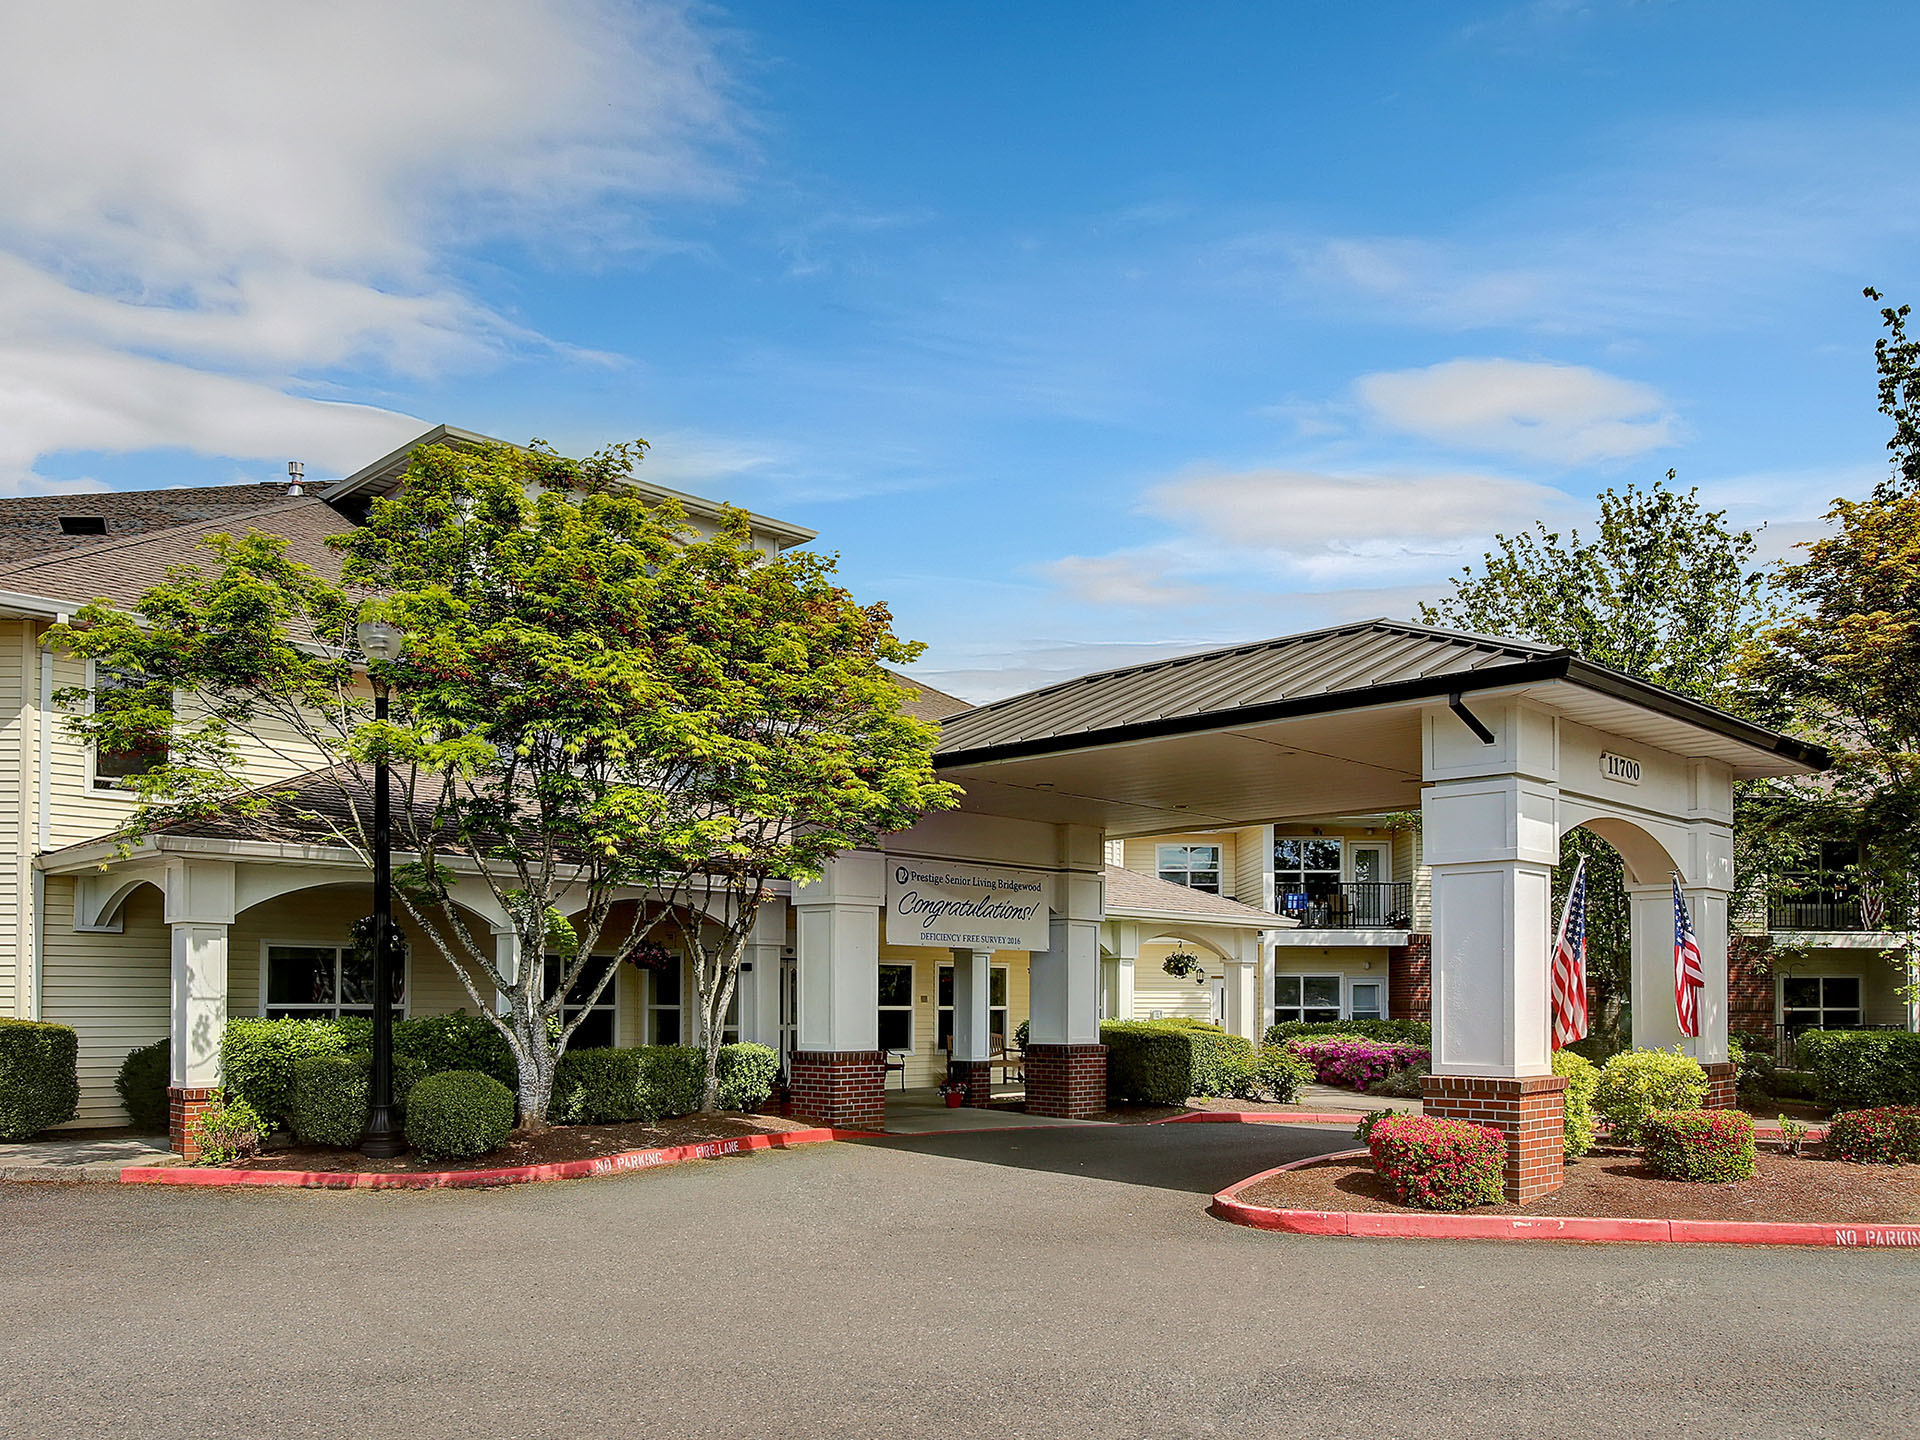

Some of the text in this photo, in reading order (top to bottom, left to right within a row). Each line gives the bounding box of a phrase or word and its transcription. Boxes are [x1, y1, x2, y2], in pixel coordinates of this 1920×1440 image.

[1608, 756, 1640, 780] 11700
[911, 871, 1042, 892] Prestige Senior Living Bridgewood
[898, 891, 1040, 928] Congratulations!
[920, 932, 1021, 945] DEFICIENCY FREE SURVEY 2016
[696, 1140, 739, 1158] FIRE LANE
[595, 1152, 663, 1173] NO PARKING
[1835, 1229, 1857, 1245] NO
